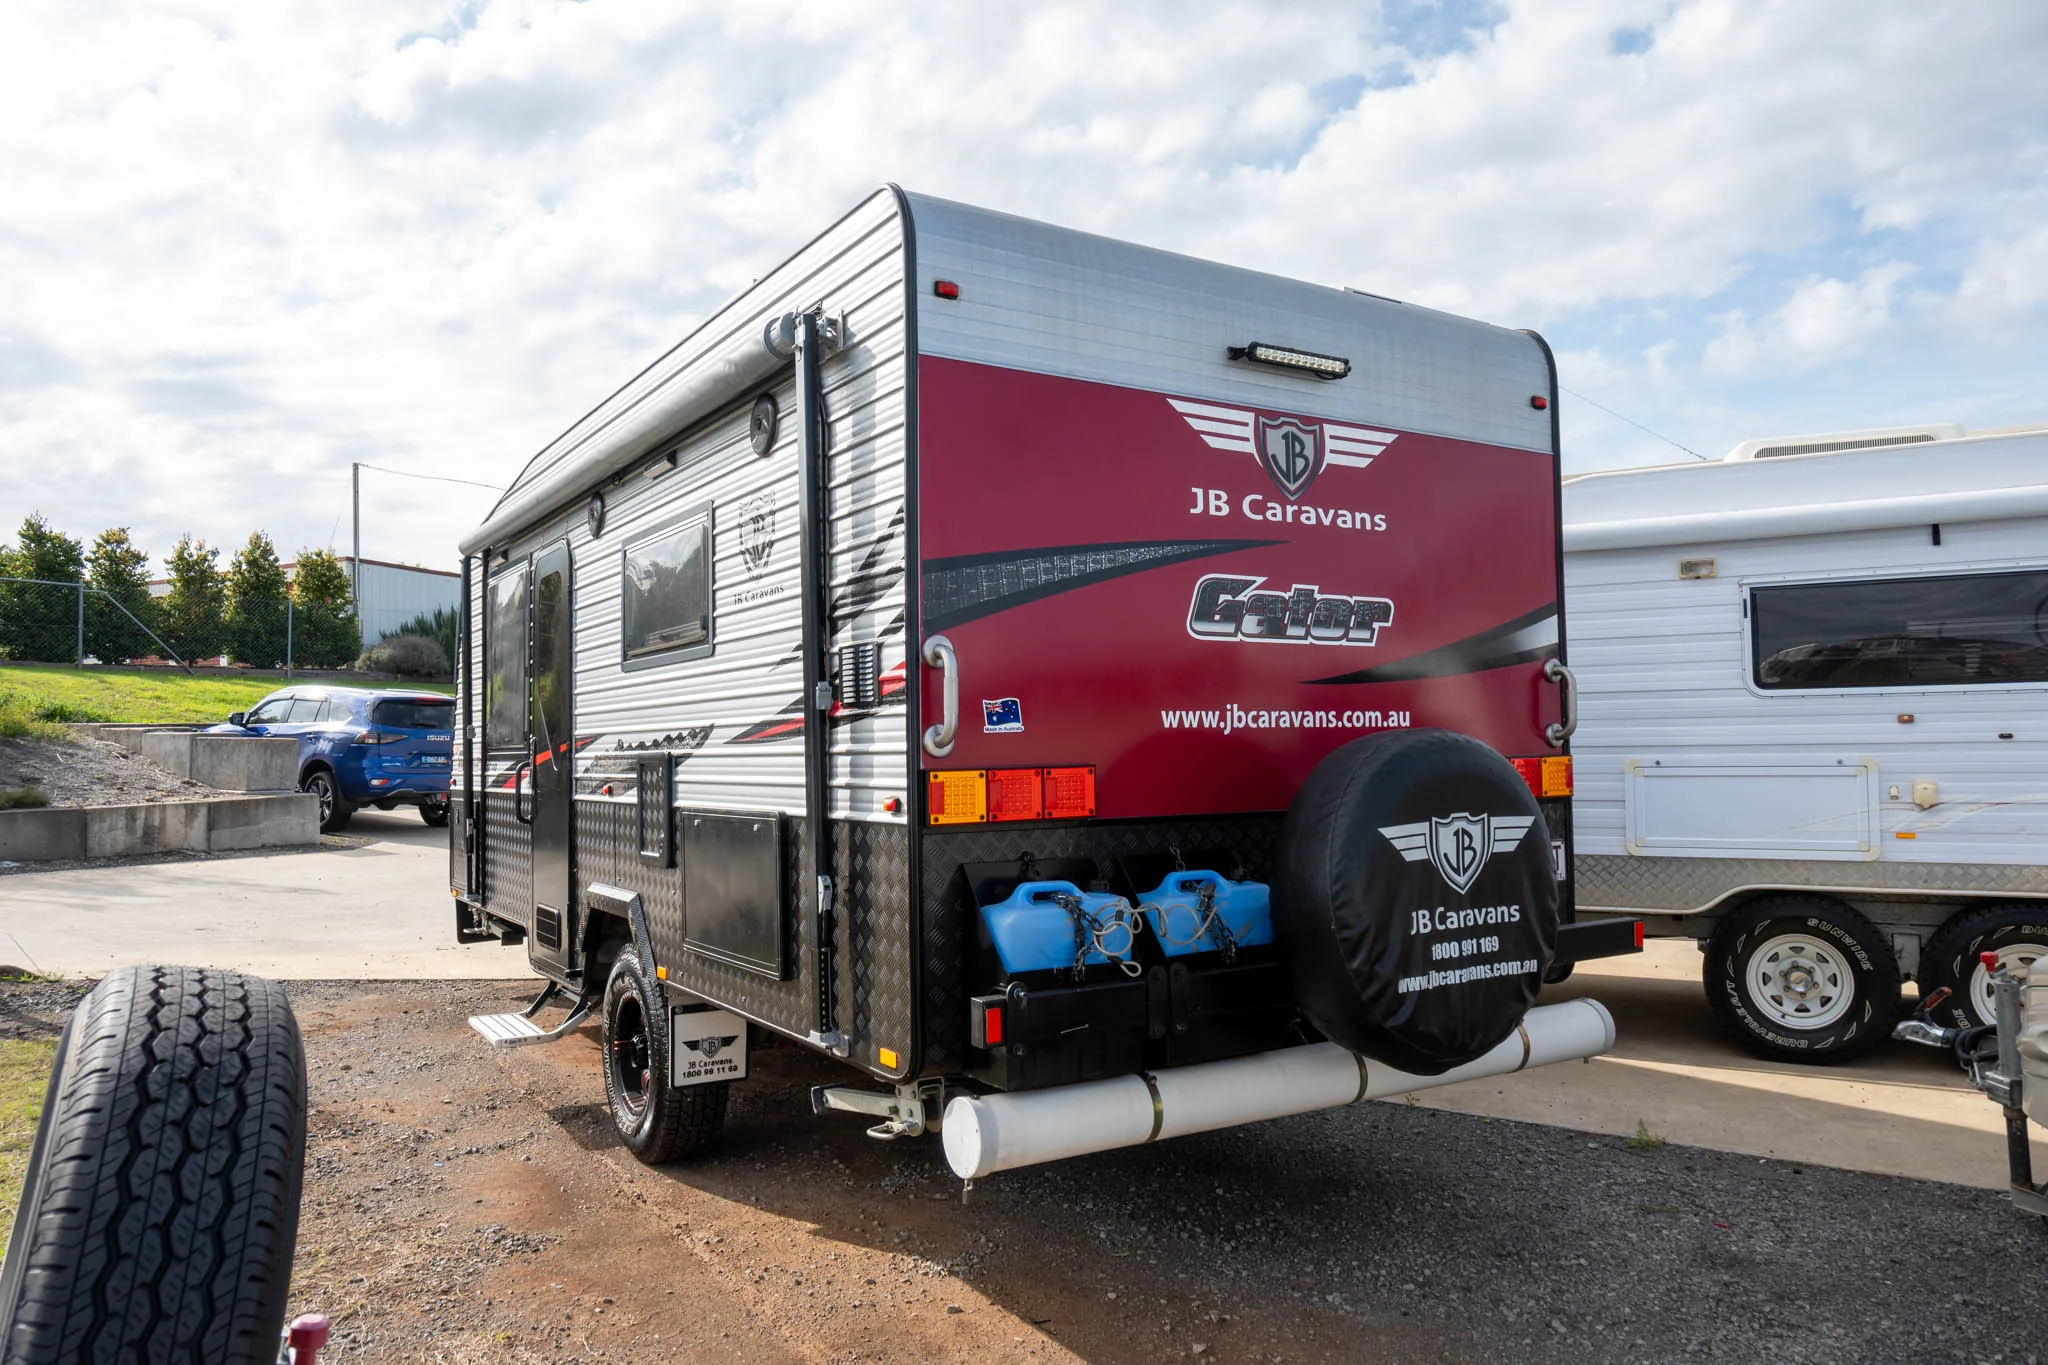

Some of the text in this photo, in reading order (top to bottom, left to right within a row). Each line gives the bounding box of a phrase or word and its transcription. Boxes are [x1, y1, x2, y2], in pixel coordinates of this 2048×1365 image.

[1271, 431, 1310, 485] JB
[1190, 488, 1387, 532] JB Caravans
[744, 585, 784, 603] Caravans
[1186, 573, 1395, 647] Gator
[1161, 704, 1411, 735] www.jbcaravans.com.au
[1443, 829, 1478, 876] JB
[1410, 904, 1521, 935] JB Caravans
[1431, 935, 1499, 961] 1800 991 169
[1398, 959, 1538, 994] www.jbcaravans.com.au
[682, 1070, 702, 1079] 1800
[704, 1068, 714, 1076] 99
[717, 1066, 725, 1074] 11
[688, 1058, 733, 1069] JB Caravans
